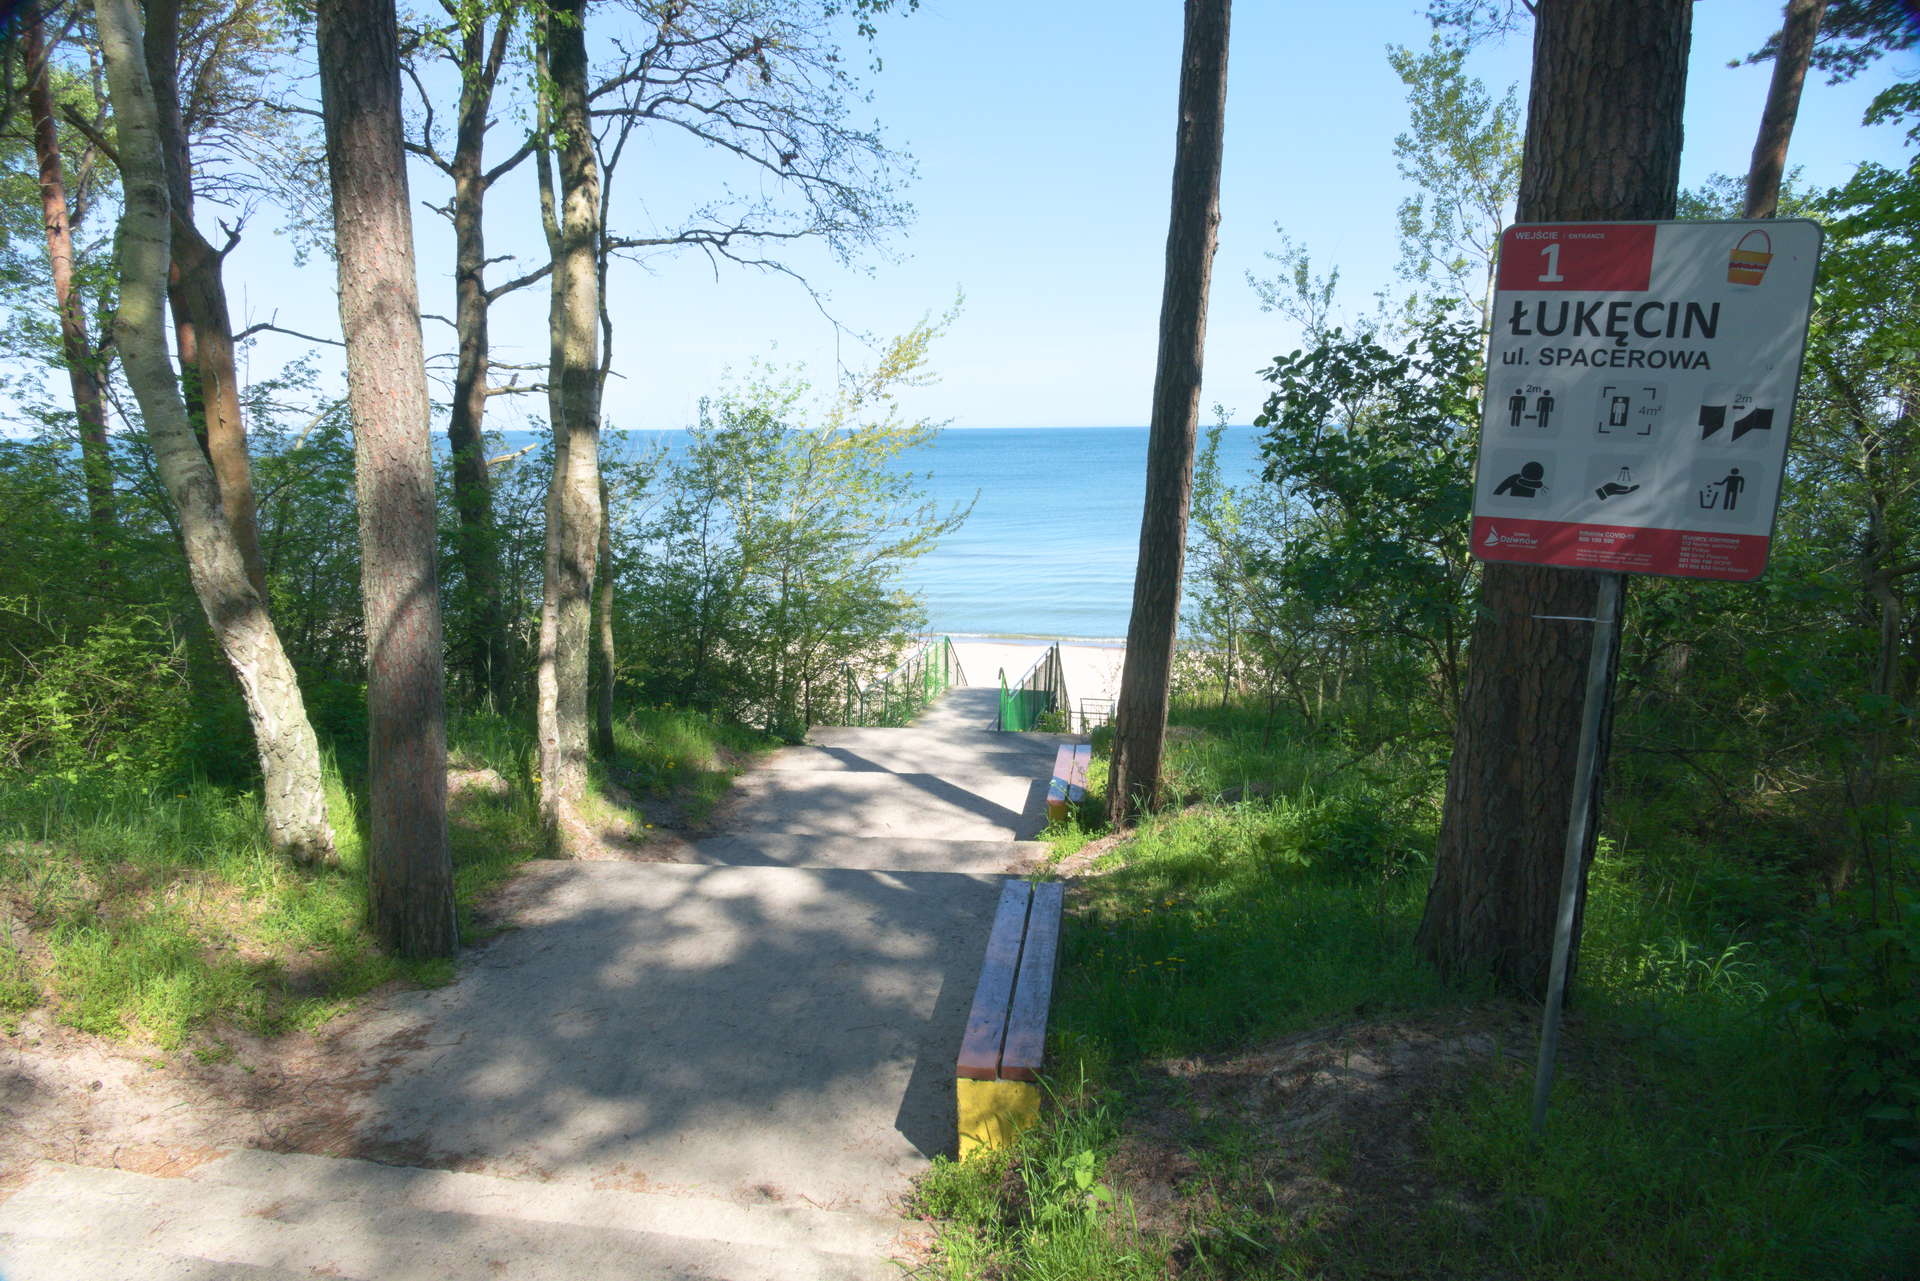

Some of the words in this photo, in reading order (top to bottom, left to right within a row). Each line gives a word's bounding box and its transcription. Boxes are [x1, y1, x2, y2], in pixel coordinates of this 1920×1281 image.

[1515, 229, 1558, 240] WEJŚCIE
[1538, 243, 1564, 282] 1
[1508, 300, 1721, 347] ŁUKĘCIN
[1502, 347, 1530, 366] ul.
[1538, 348, 1712, 370] SPACEROWA
[1526, 384, 1542, 393] 2m
[1735, 393, 1753, 404] 2m
